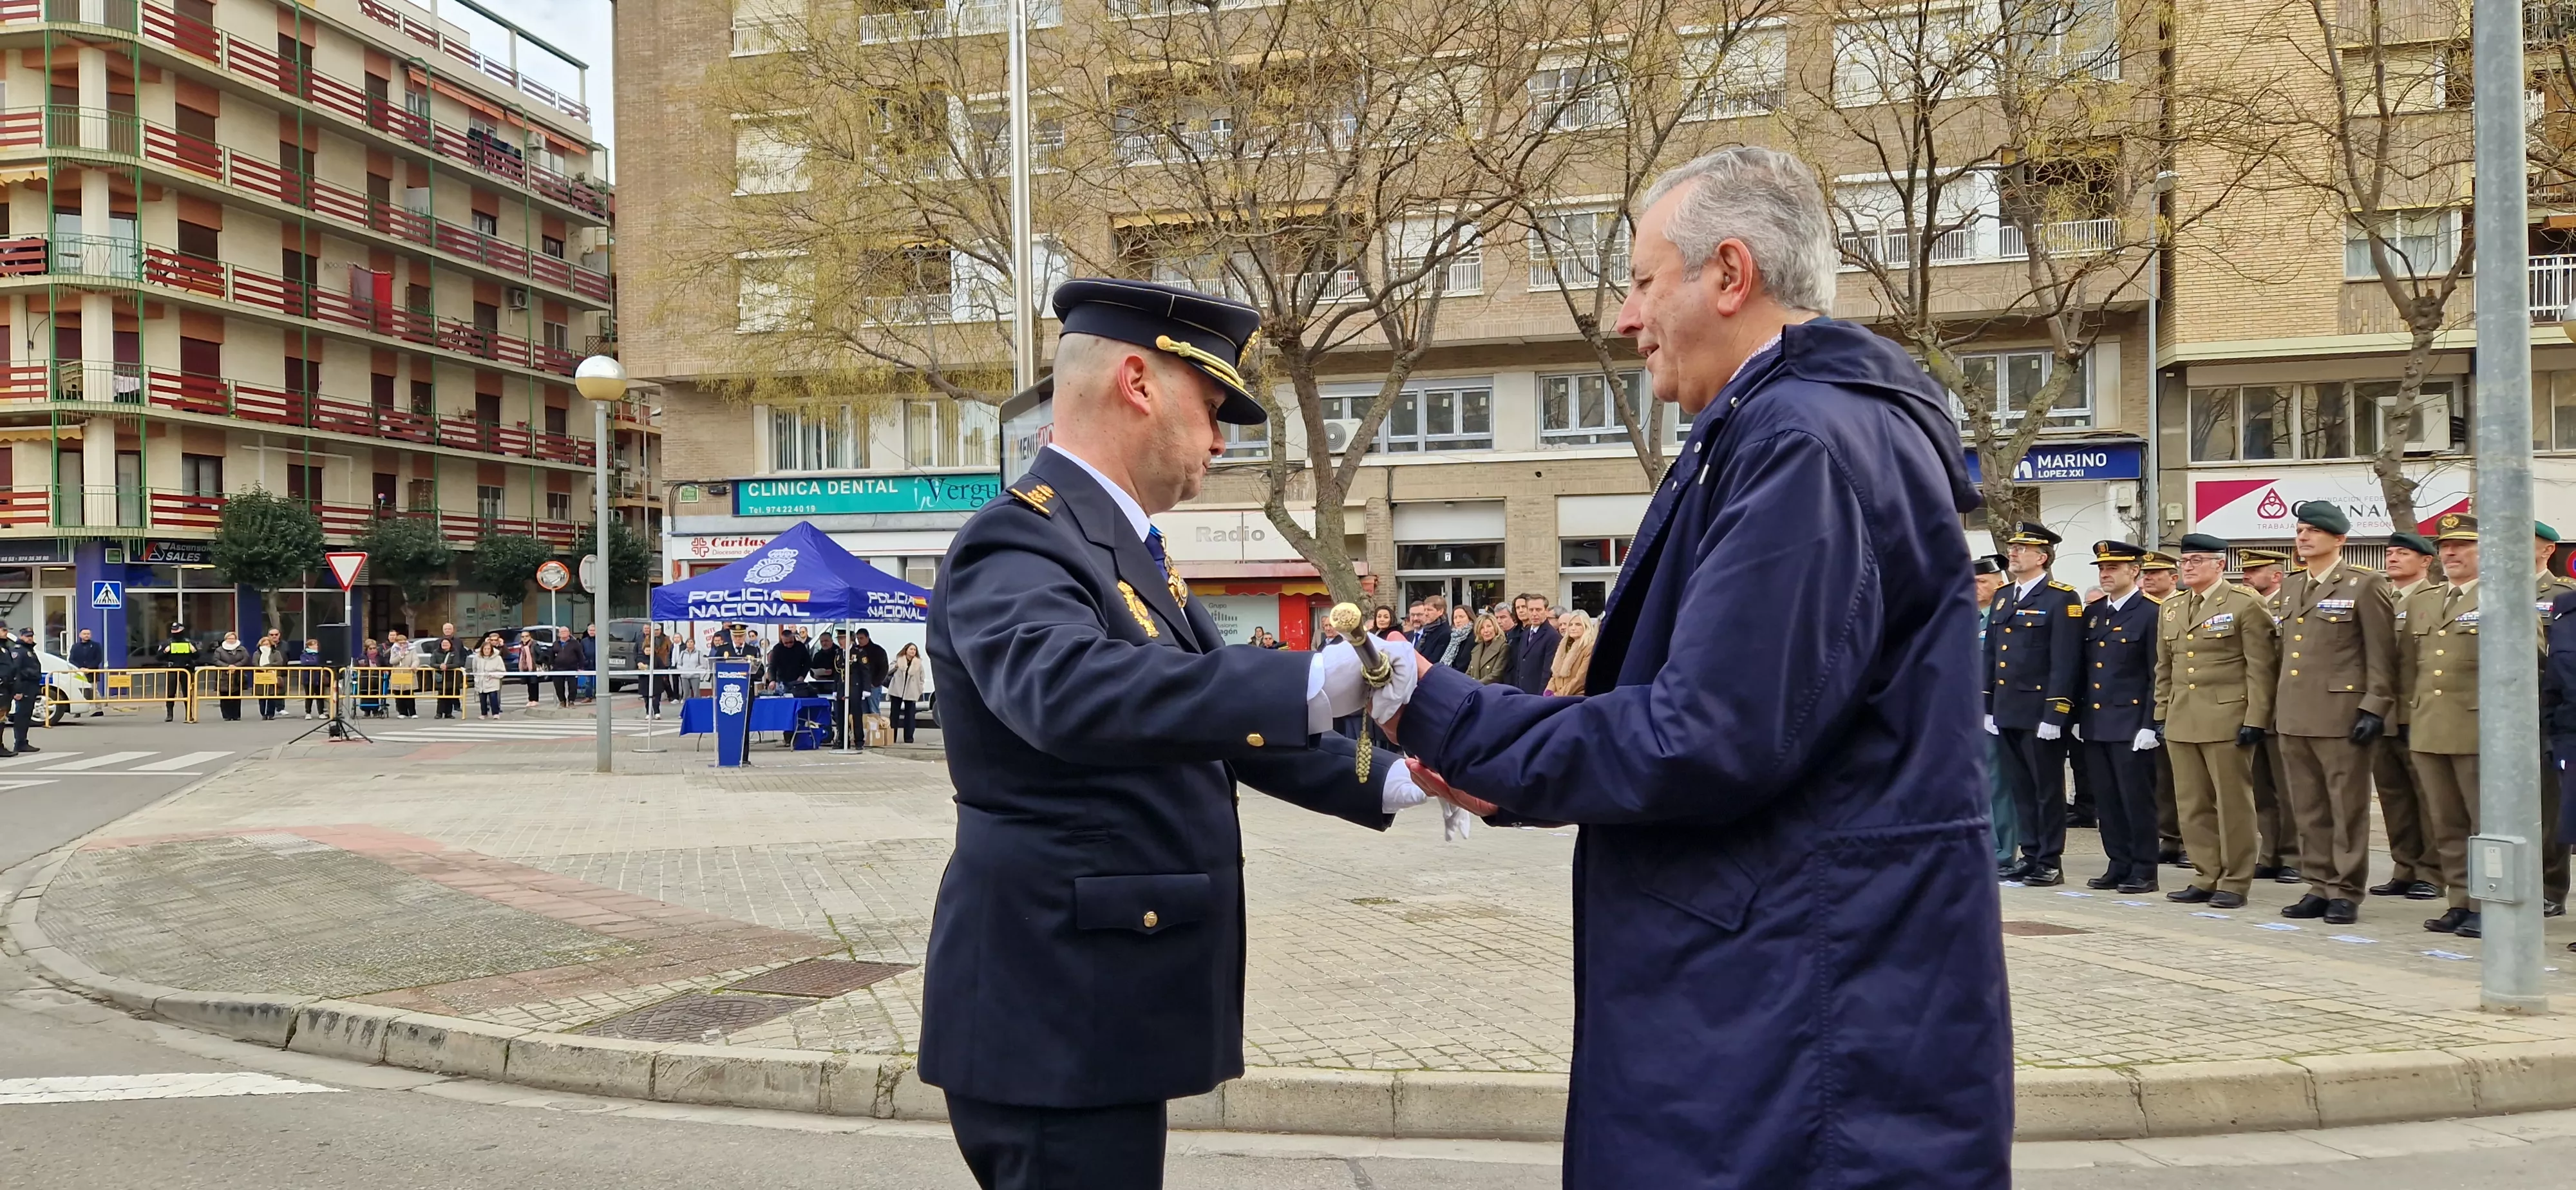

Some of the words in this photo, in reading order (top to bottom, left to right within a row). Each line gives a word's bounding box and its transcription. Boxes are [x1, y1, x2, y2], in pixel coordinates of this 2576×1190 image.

[2038, 453, 2107, 469] MARINO
[748, 481, 821, 496] CLINICA
[828, 479, 898, 495] DENTAL
[712, 536, 766, 547] Cáritas
[1196, 526, 1265, 542] Radio
[166, 552, 200, 562] SALES
[688, 587, 784, 603] POLICIA
[867, 591, 914, 605] POLICIA
[688, 603, 810, 618] NACIONAL
[867, 605, 925, 620] NACIONAL
